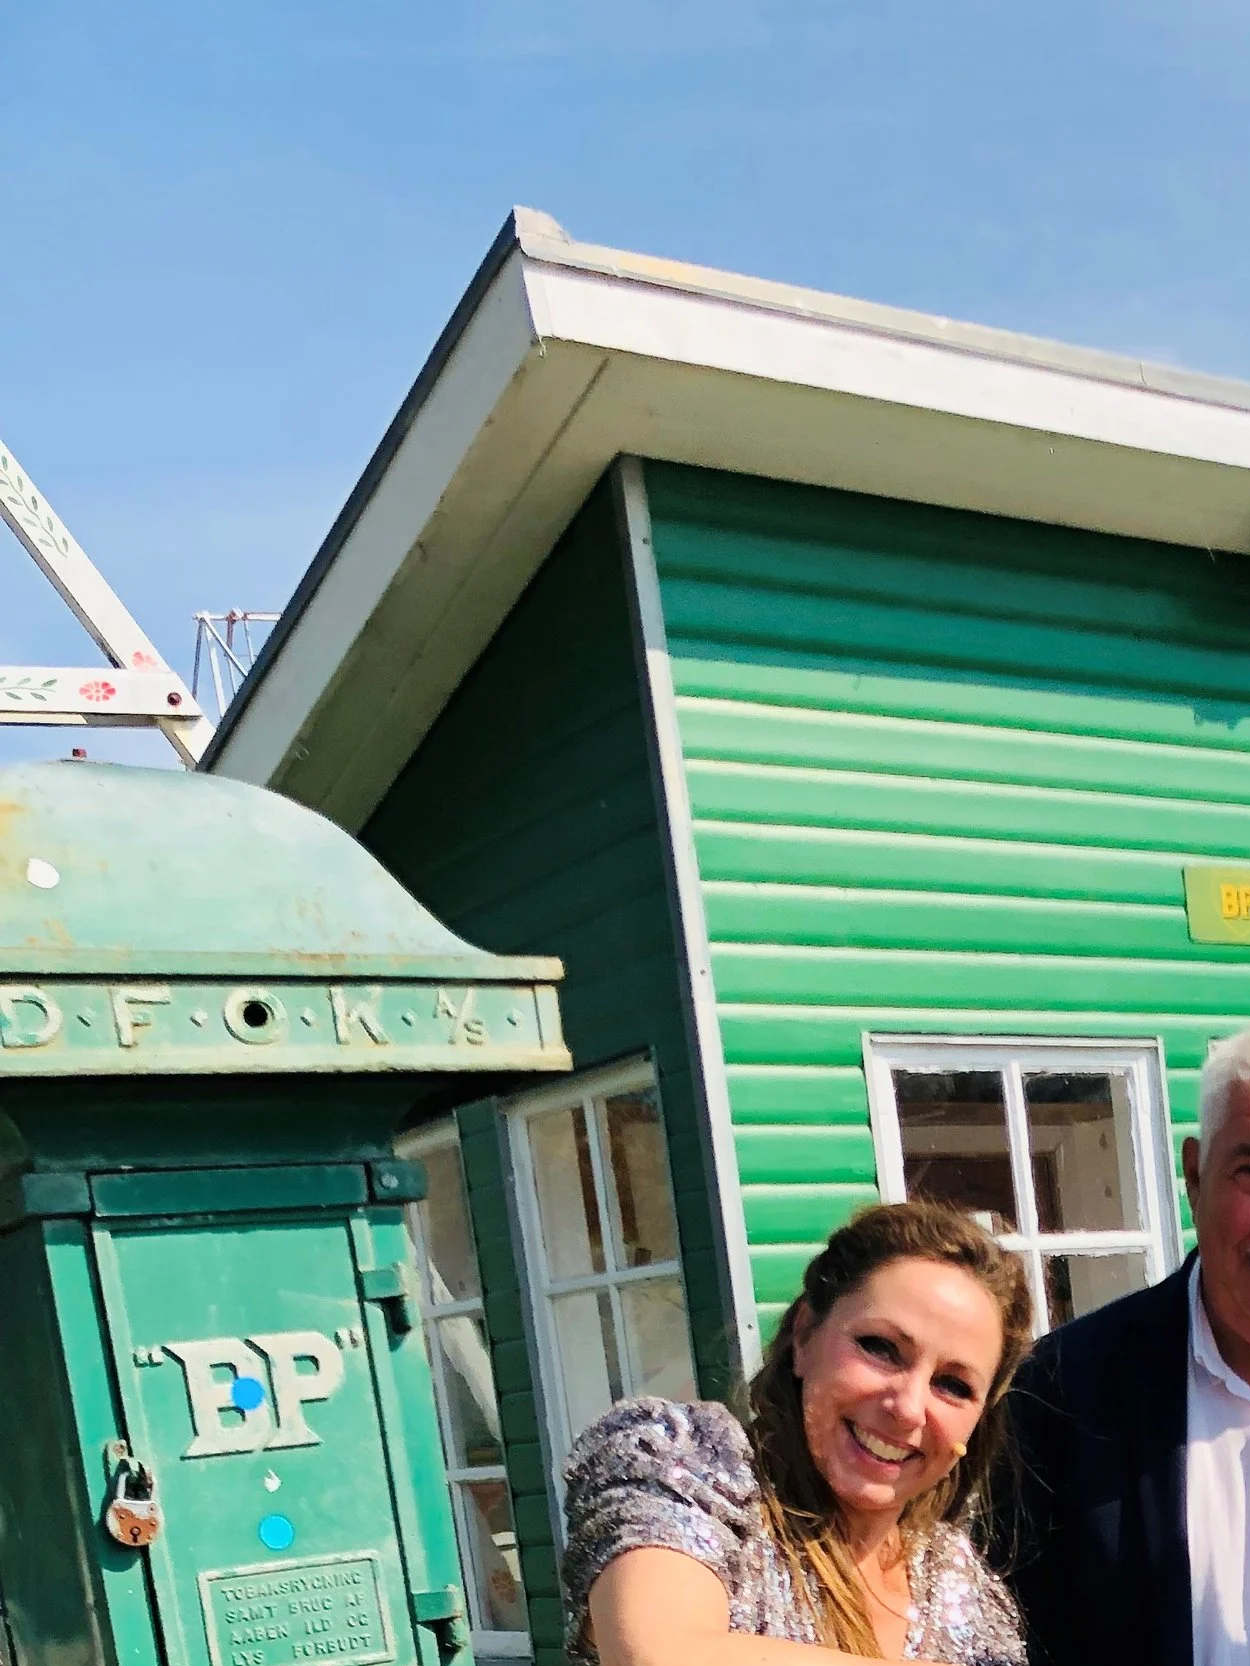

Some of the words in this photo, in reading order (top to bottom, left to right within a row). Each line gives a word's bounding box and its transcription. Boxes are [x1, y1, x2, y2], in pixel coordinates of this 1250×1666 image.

[224, 1604, 278, 1624] SAMT
[345, 1592, 365, 1608] AF
[229, 1623, 289, 1646] AABEN
[304, 1618, 333, 1635] ILD
[292, 1634, 371, 1659] FORBUDT
